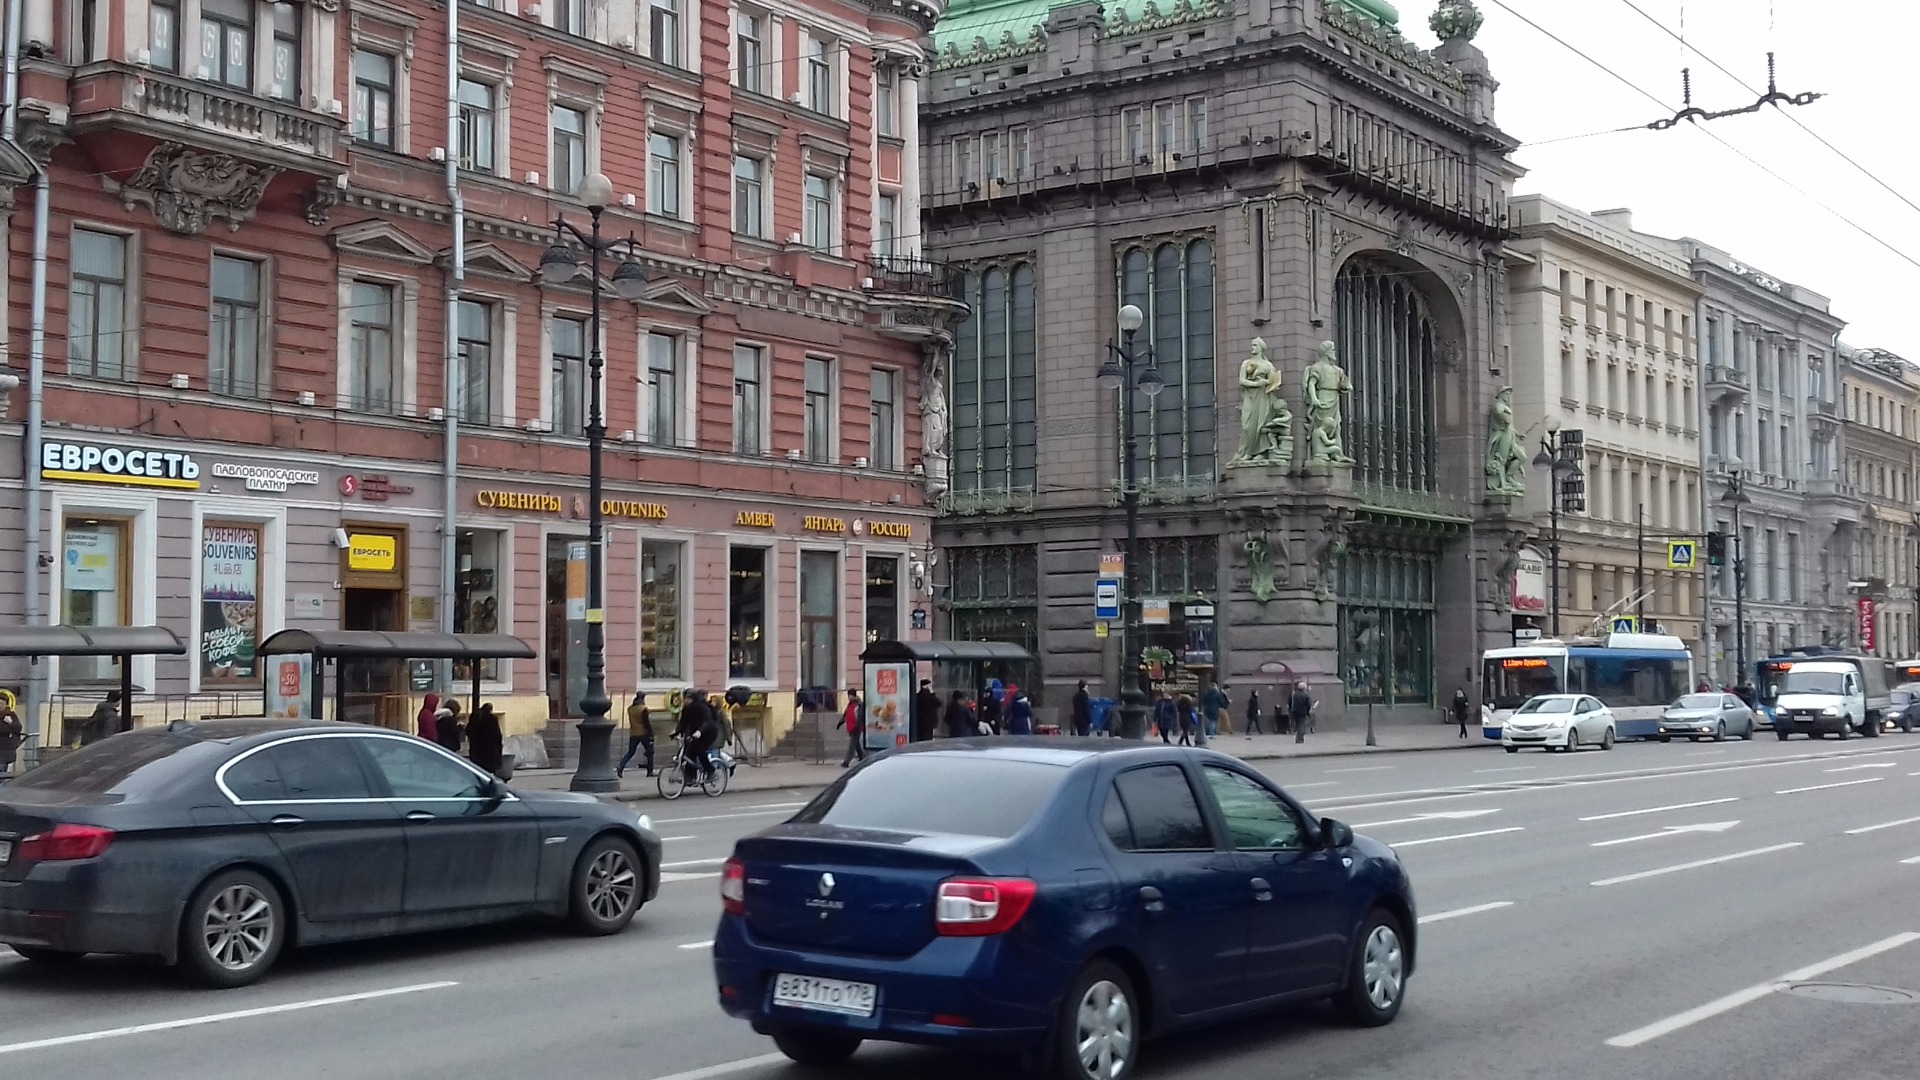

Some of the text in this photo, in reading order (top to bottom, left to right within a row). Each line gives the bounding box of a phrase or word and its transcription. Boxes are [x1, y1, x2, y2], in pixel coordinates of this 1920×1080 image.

[43, 443, 200, 479] ЕВРОСЕТЬ
[215, 464, 318, 483] ПАВЛОВОПОСАДСКИЕ
[249, 478, 286, 490] ПЛАТКИ
[477, 490, 562, 512] СУВЕНИРЫ
[600, 499, 669, 518] OUVENIRS
[736, 511, 775, 528] AMBER
[804, 516, 911, 537] ЯНТАРЬ РОССИИ
[203, 527, 256, 544] СУВЕНИРЫ
[203, 543, 256, 560] SOUVENIRS
[353, 547, 391, 557] ЕВРОСЕТЬ
[208, 644, 239, 662] КОФЕ
